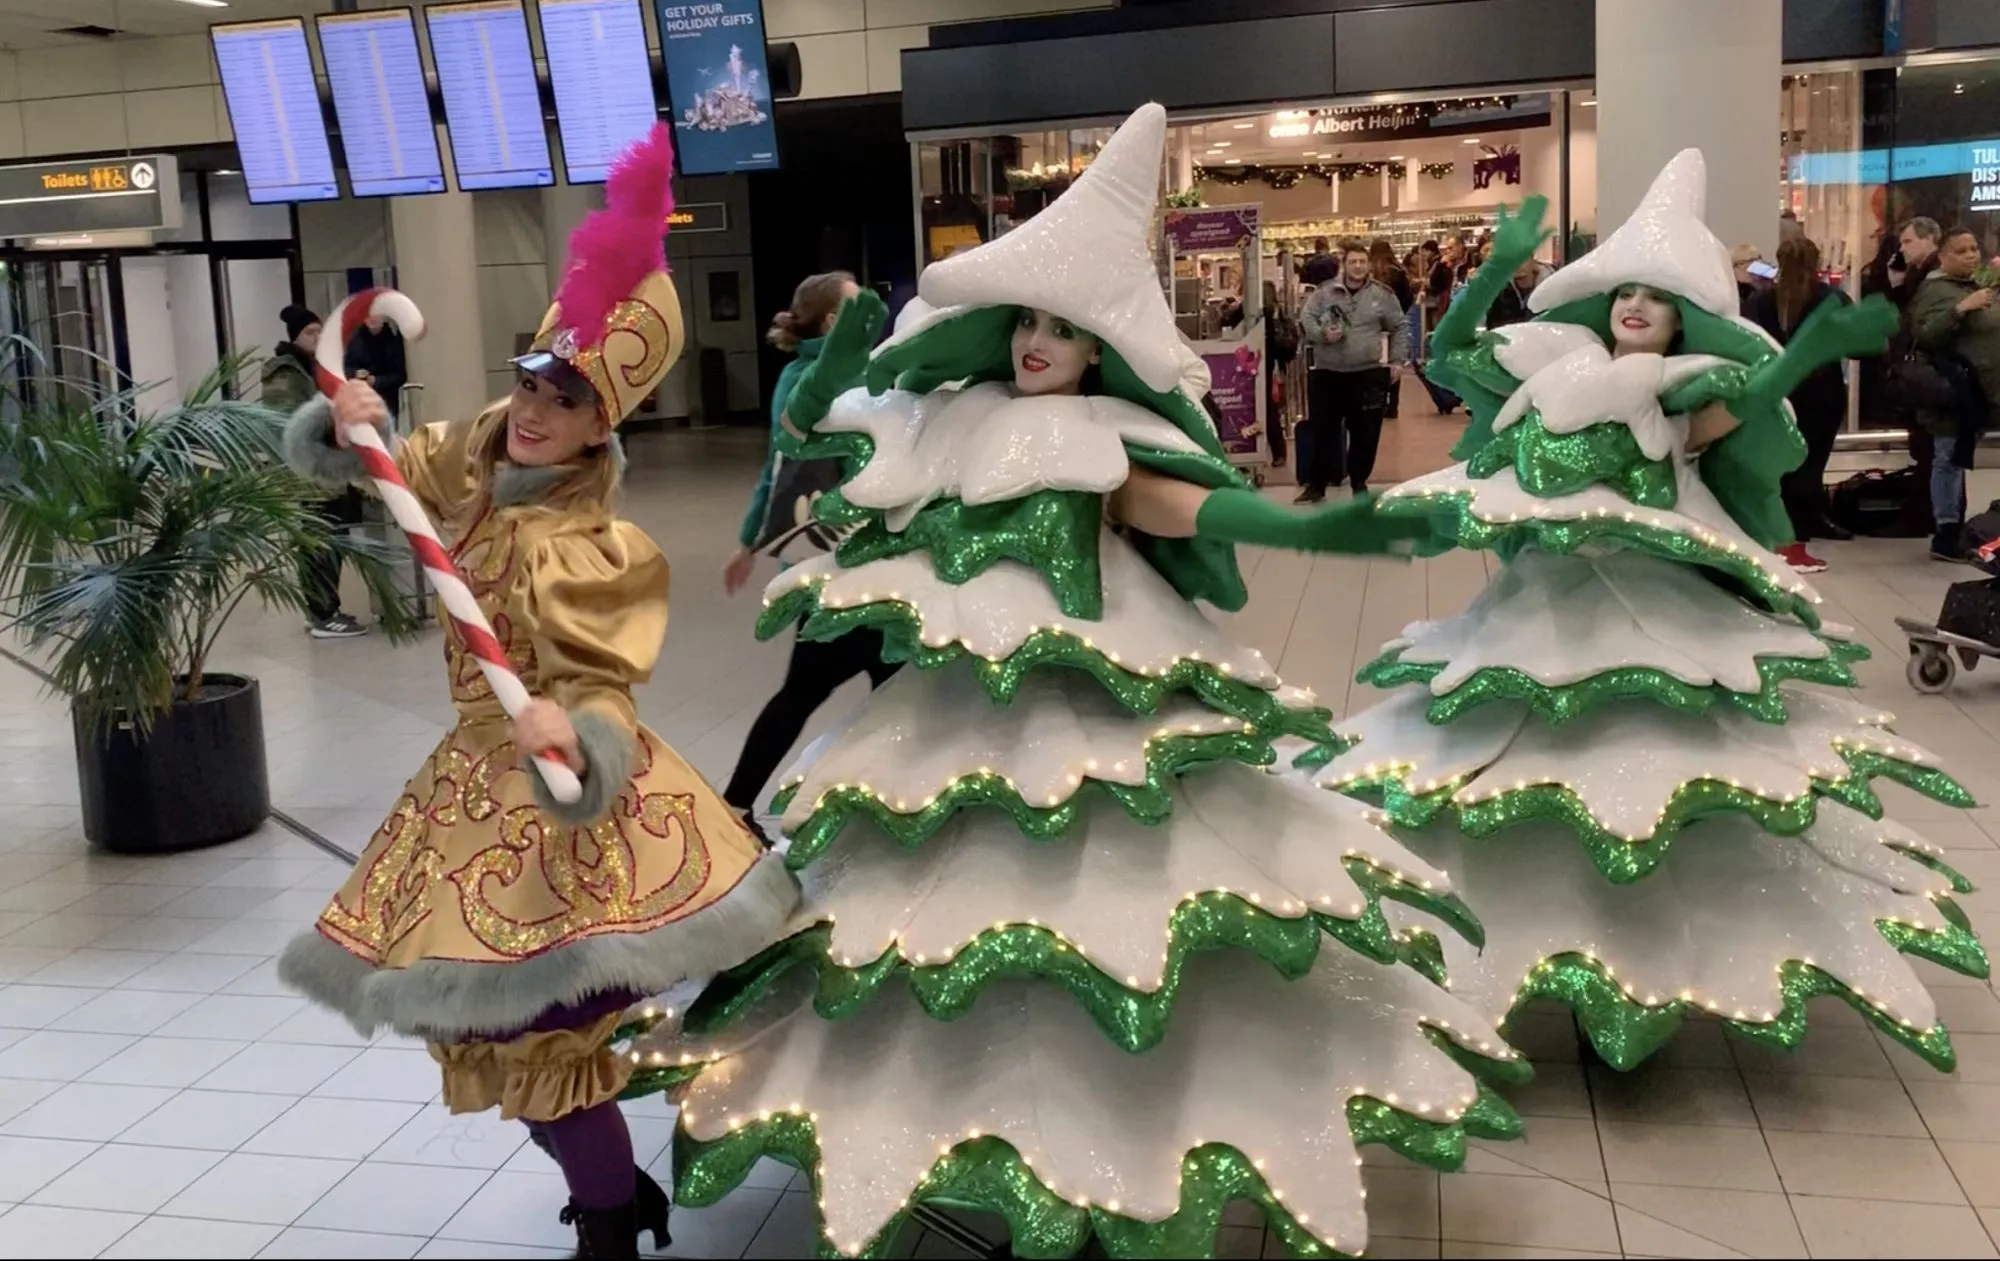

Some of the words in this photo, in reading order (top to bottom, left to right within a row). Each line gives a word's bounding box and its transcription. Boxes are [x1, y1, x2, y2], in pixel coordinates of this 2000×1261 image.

[665, 7, 687, 18] GET
[689, 3, 724, 16] YOUR
[667, 18, 718, 31] HOLIDAY
[721, 13, 754, 26] GIFTS
[1312, 117, 1364, 134] Albert
[41, 173, 88, 188] Toilets
[664, 213, 693, 223] oilets
